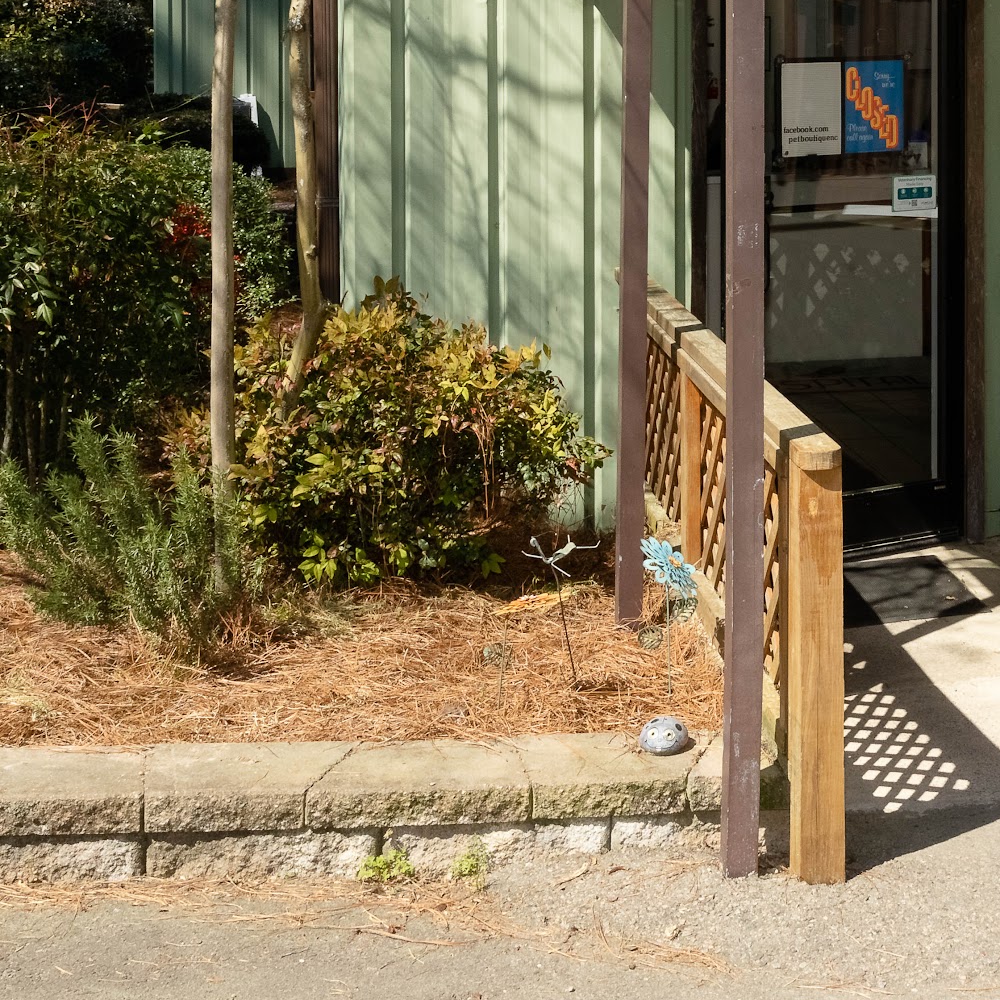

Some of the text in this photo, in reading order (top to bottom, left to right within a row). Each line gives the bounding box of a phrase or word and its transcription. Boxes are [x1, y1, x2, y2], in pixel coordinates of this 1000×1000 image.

[845, 66, 899, 149] CLOSED
[783, 125, 829, 134] facebook.com
[788, 135, 839, 145] petboutiquenc
